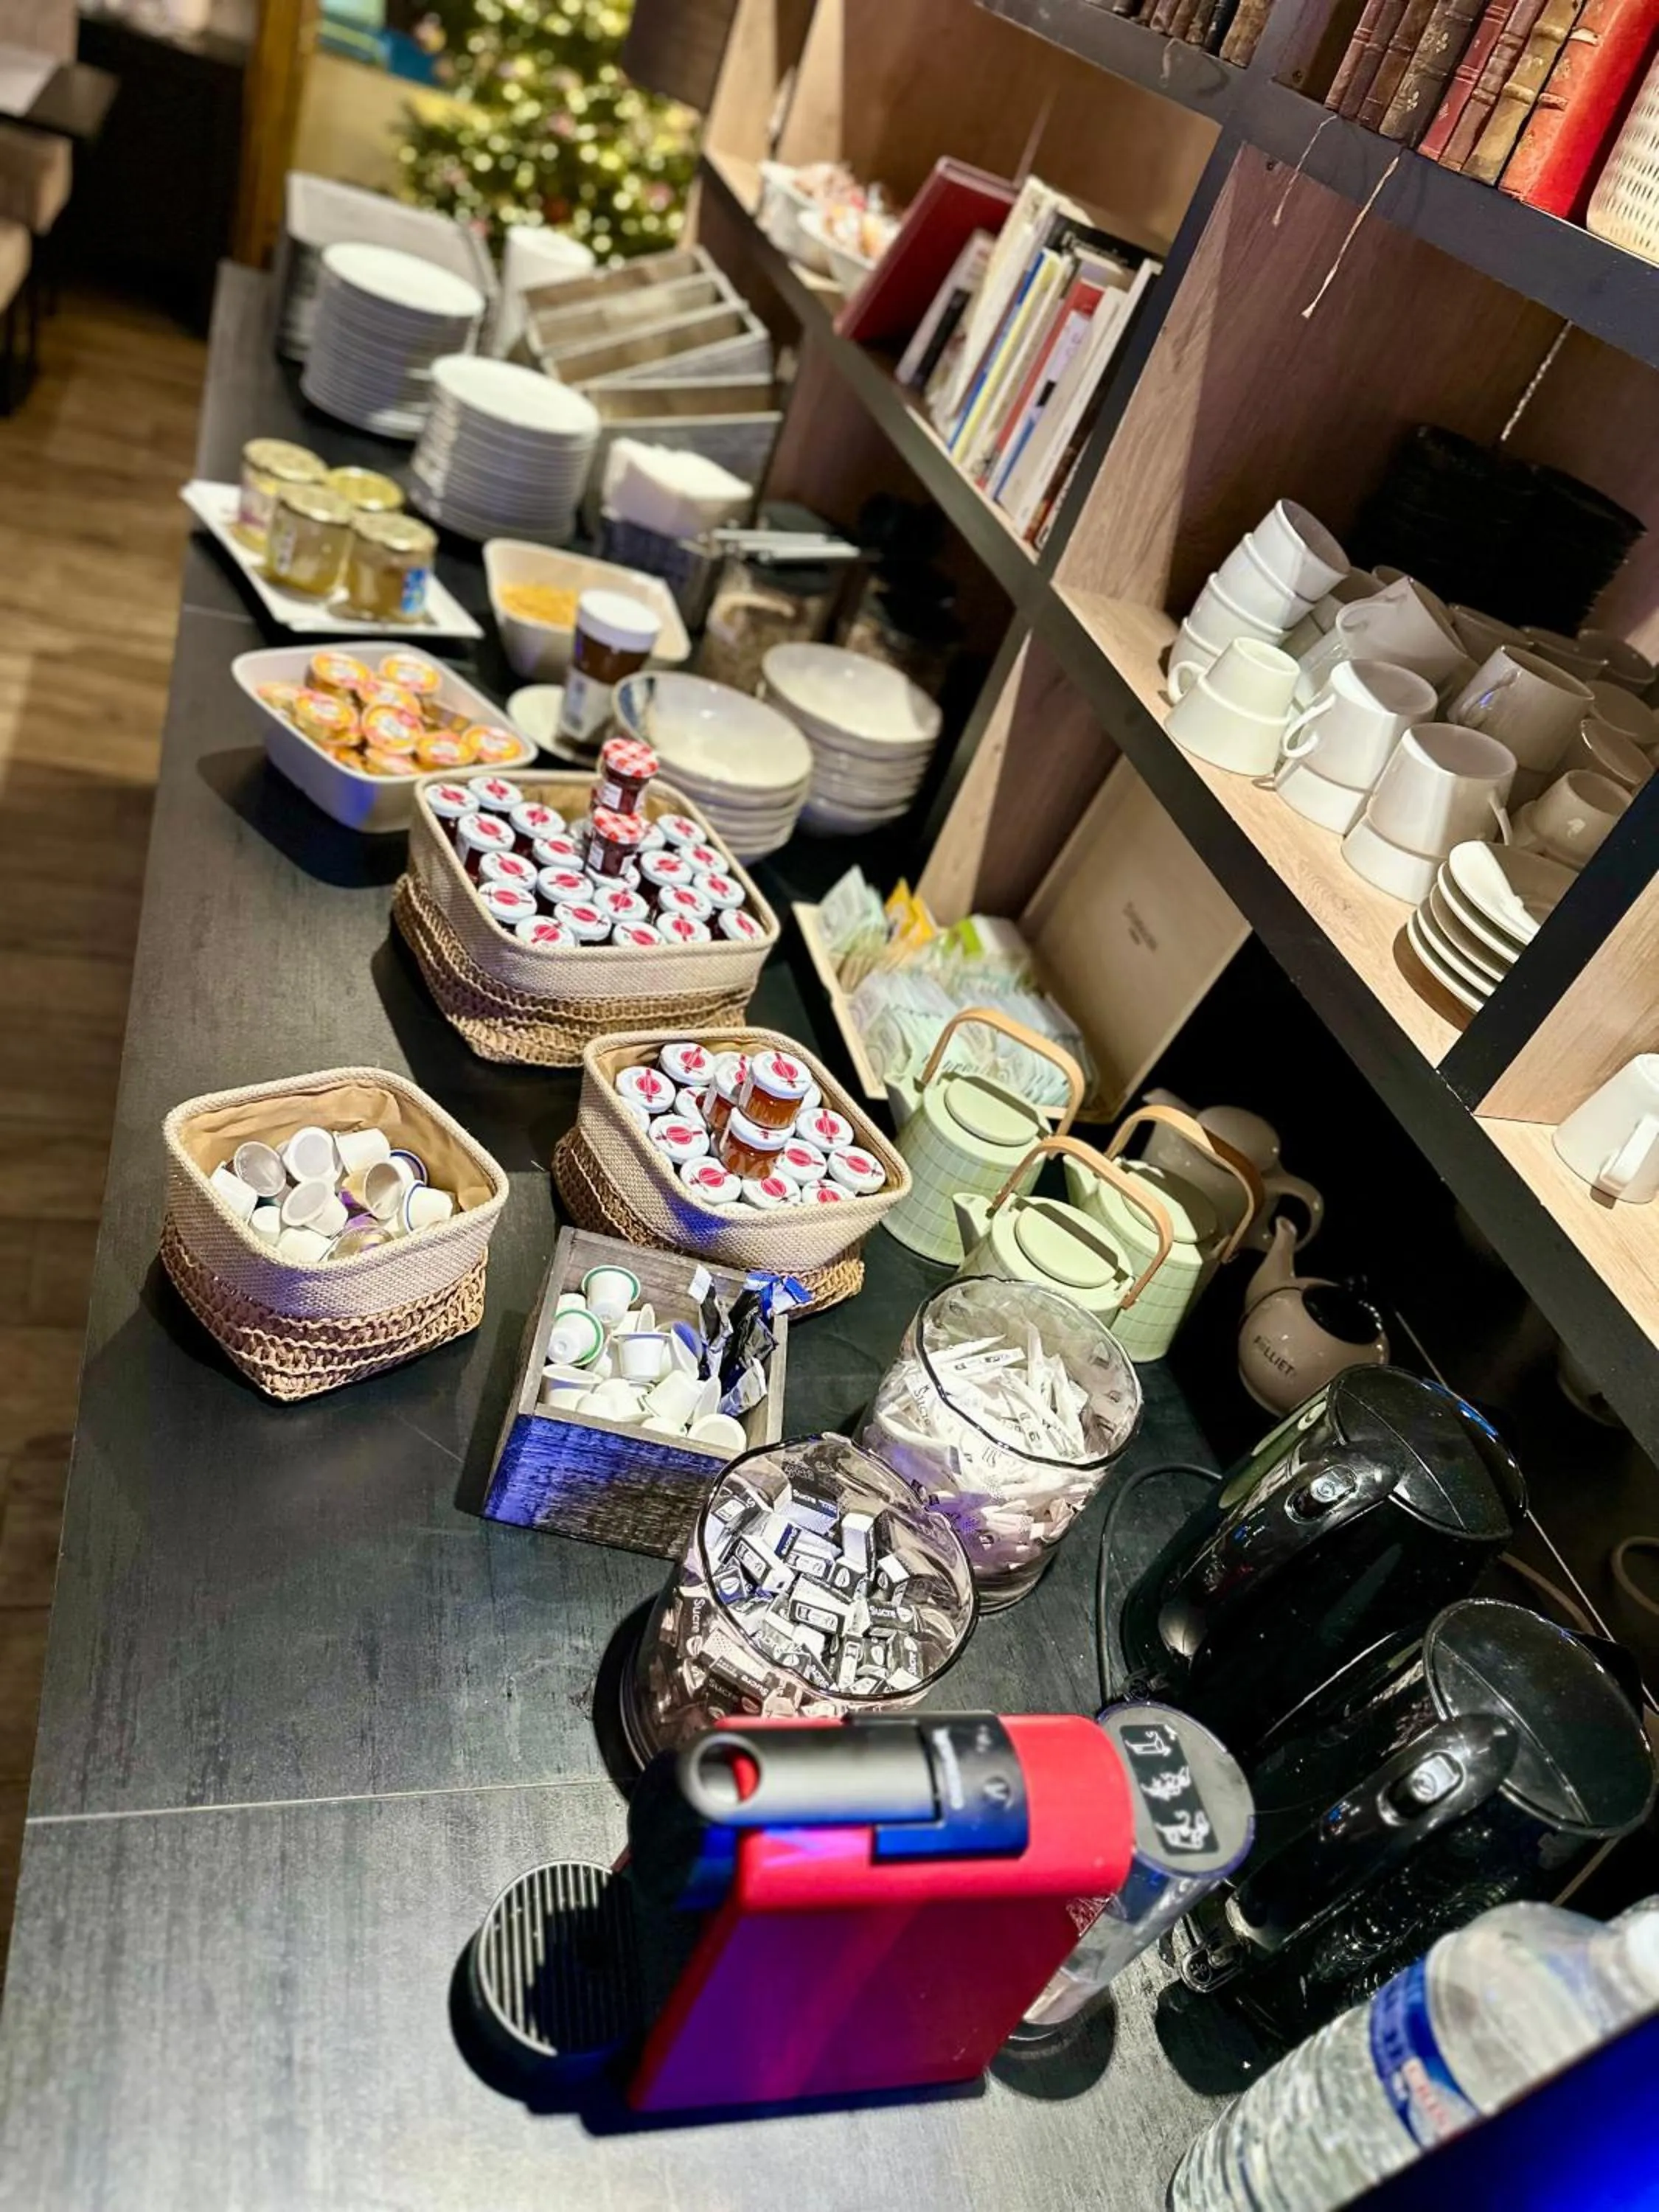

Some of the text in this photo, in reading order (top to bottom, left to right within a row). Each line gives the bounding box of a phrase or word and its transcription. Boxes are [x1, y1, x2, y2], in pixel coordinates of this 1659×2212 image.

[1254, 1335, 1295, 1375] LLIET
[692, 1598, 706, 1633] Sucre
[740, 1674, 769, 1697] Sucre
